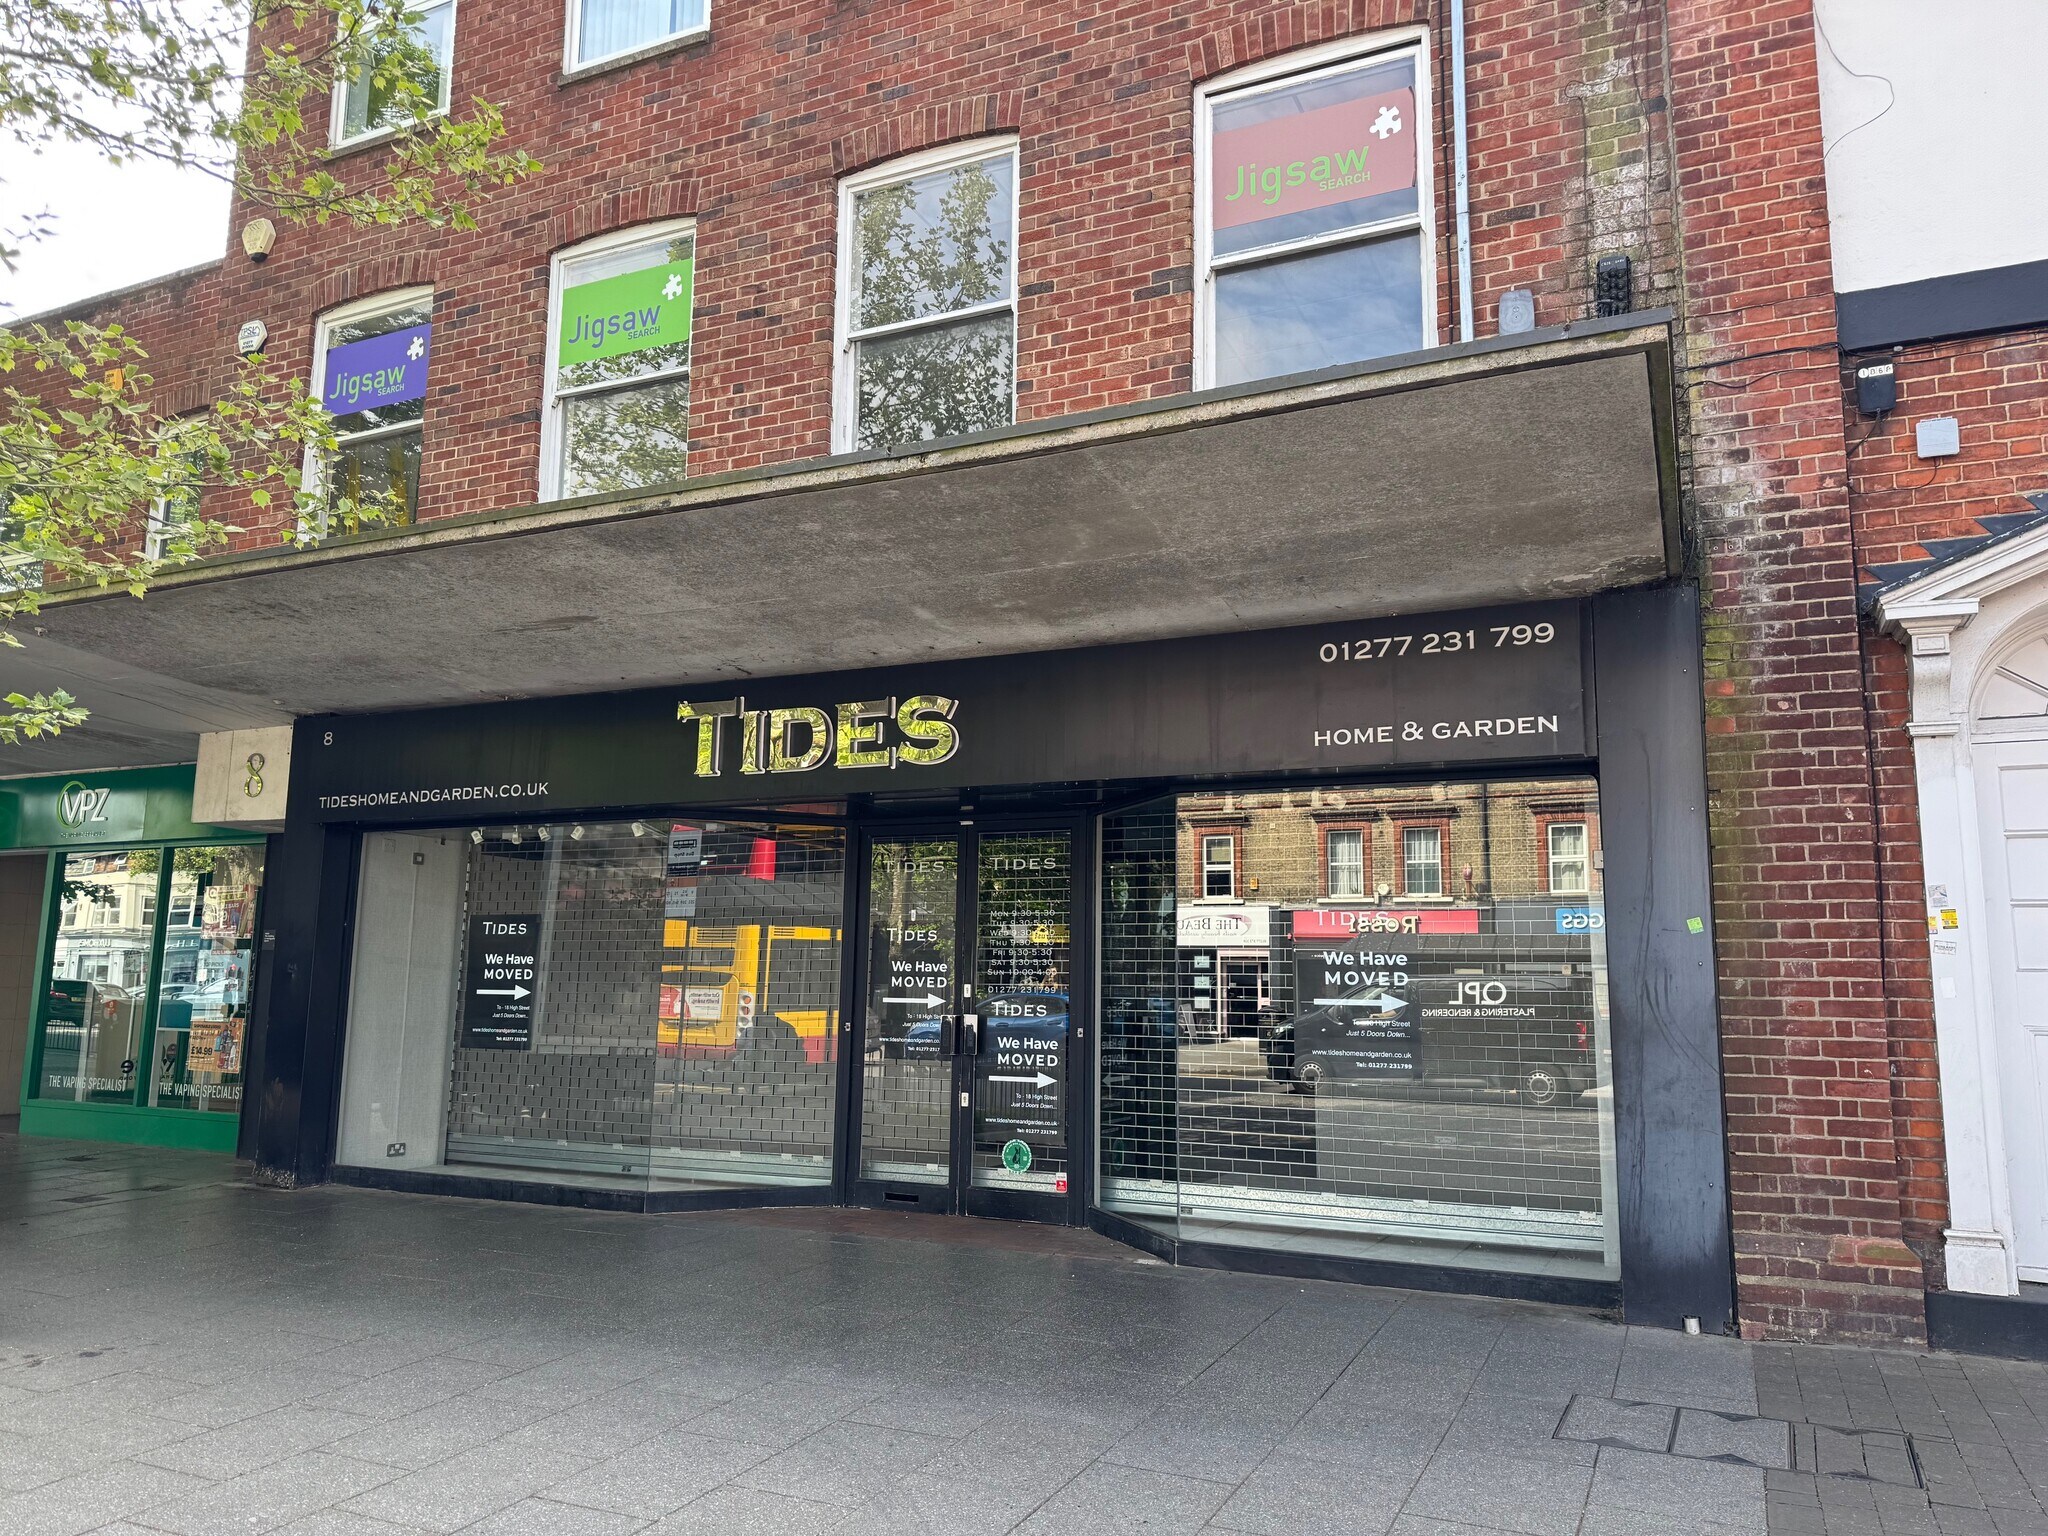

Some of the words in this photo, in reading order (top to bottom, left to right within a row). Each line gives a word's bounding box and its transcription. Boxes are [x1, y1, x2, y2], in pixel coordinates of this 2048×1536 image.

[1225, 146, 1369, 205] Jigsaw
[1319, 171, 1371, 191] SEARCH
[568, 305, 661, 349] Jigsaw
[627, 326, 661, 340] SEARCH
[329, 365, 406, 404] Jigsaw
[377, 383, 405, 397] SEARCH
[1320, 635, 1412, 663] 01277
[1422, 629, 1475, 654] 231
[1490, 622, 1555, 647] 799
[677, 695, 960, 777] TIDES
[1314, 726, 1393, 747] HOME
[1401, 721, 1424, 741] &
[1431, 715, 1558, 741] GARDEN
[323, 731, 333, 746] 8
[244, 753, 265, 798] 8
[319, 782, 549, 809] TIDESHOMEANDGARDEN.CO.UK
[63, 788, 111, 823] VPZ
[883, 860, 945, 873] TIDES
[989, 857, 1056, 871] TIDES
[482, 921, 527, 935] TIDES
[886, 928, 938, 942] TIDES
[485, 953, 504, 965] We
[506, 953, 534, 965] Have
[1008, 948, 1053, 956] 9:30-5:30
[1323, 951, 1355, 966] We
[1360, 951, 1408, 966] Have
[891, 960, 913, 972] We
[915, 961, 948, 973] Have
[484, 968, 533, 980] MOVED
[1324, 971, 1409, 986] MOVED
[891, 976, 948, 988] MOVED
[987, 986, 1017, 994] 01277
[991, 1001, 1048, 1017] TIDES
[922, 1013, 933, 1021] High
[1391, 1020, 1411, 1028] Street
[1345, 1029, 1360, 1037] Just
[1366, 1030, 1385, 1038] Doors
[997, 1036, 1020, 1049] We
[1023, 1037, 1059, 1050] Have
[997, 1053, 1059, 1067] MOVED
[1312, 1049, 1412, 1059] www.tideshomeandgarden.co.uk
[1389, 1062, 1413, 1070] 231799
[49, 1075, 62, 1088] THE
[63, 1075, 86, 1089] VAPING
[87, 1077, 127, 1092] SPECIALIST
[159, 1082, 172, 1096] THE
[174, 1082, 200, 1097] VAPING
[202, 1084, 243, 1099] SPECIALIST
[1031, 1093, 1043, 1101] High
